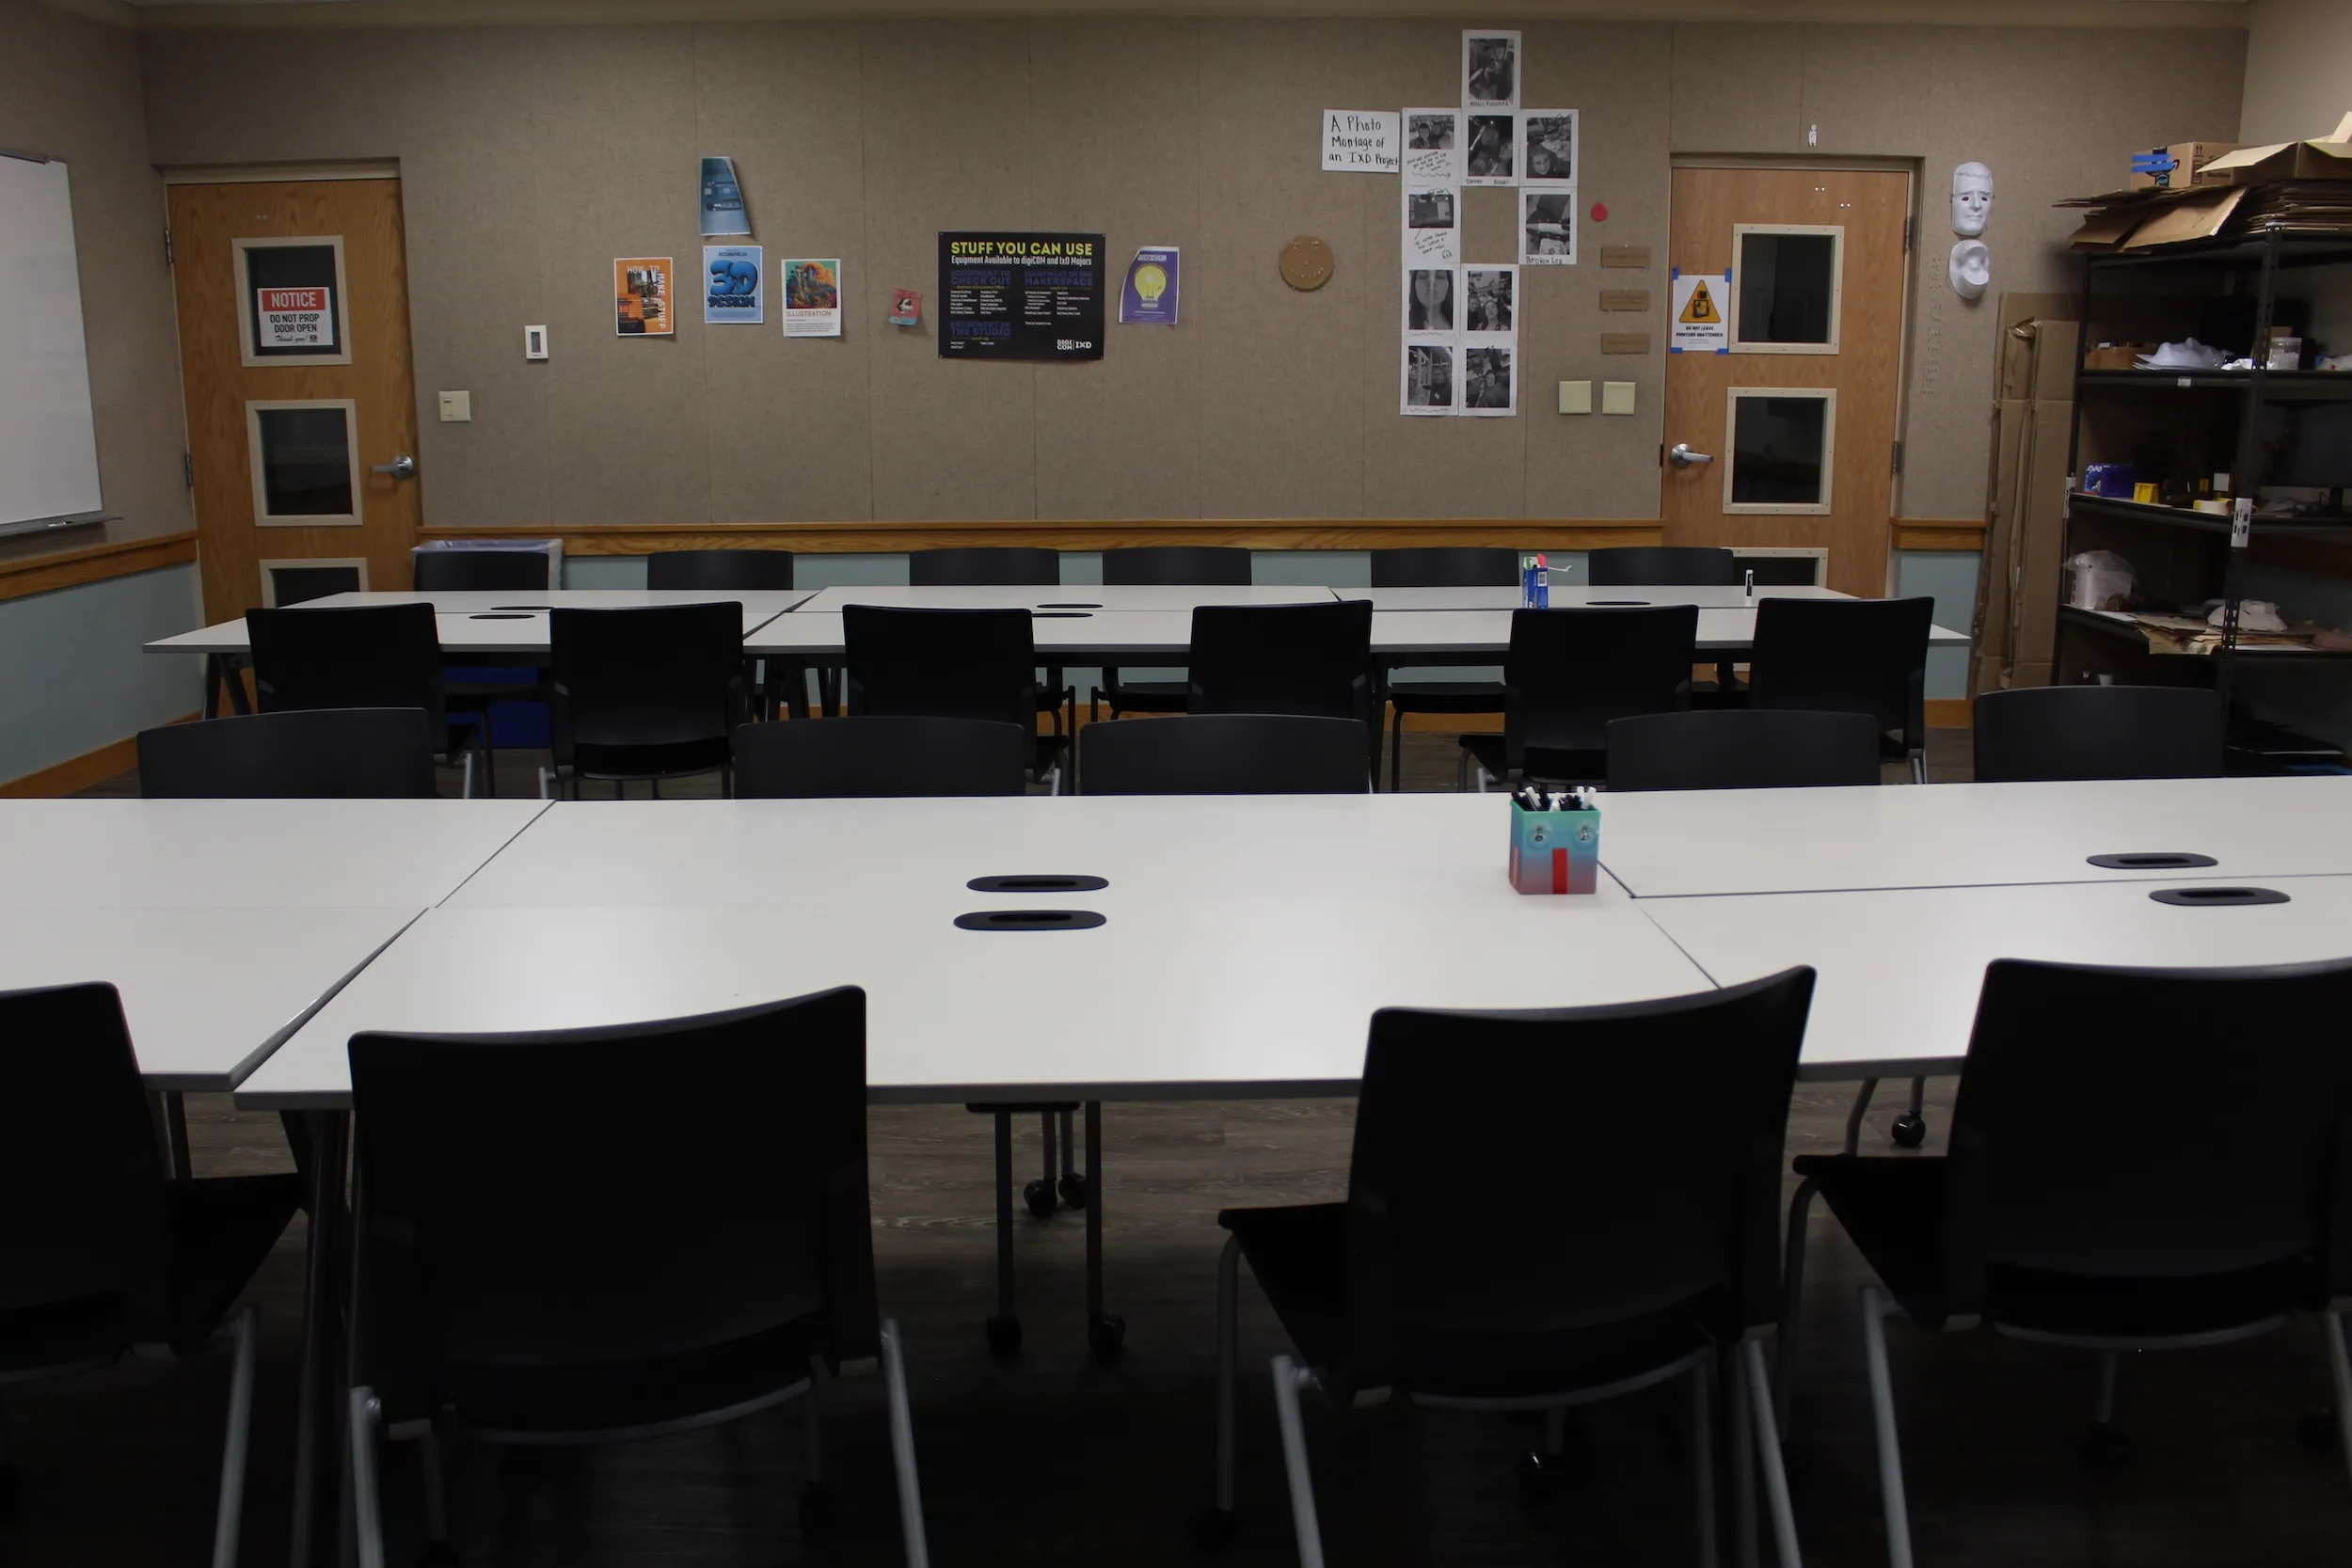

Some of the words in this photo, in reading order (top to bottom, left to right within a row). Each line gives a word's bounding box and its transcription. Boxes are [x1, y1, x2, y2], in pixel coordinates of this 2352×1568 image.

[1331, 115, 1341, 132] A
[1347, 115, 1381, 132] Photo
[1332, 135, 1373, 150] Montage
[1375, 137, 1385, 148] of
[1328, 153, 1342, 162] an
[1347, 152, 1372, 164] IXD
[1375, 153, 1399, 168] Project
[951, 242, 993, 254] STUFF
[996, 242, 1025, 255] YOU
[1030, 243, 1060, 255] CAN
[1066, 243, 1092, 256] USE
[951, 255, 983, 265] Equipment
[985, 256, 1012, 264] Available
[1071, 257, 1091, 266] Majors
[627, 265, 644, 274] HOW
[709, 259, 758, 295] 3D
[1025, 277, 1092, 286] MAKERSPACE
[658, 273, 666, 296] MAKE
[271, 292, 316, 308] NOTICE
[707, 295, 755, 308] DESIGN
[270, 314, 280, 323] DO
[282, 314, 296, 323] NOT
[299, 313, 319, 322] PROP
[658, 299, 666, 329] STUFF
[275, 325, 294, 333] DOOR
[297, 324, 317, 332] OPEN
